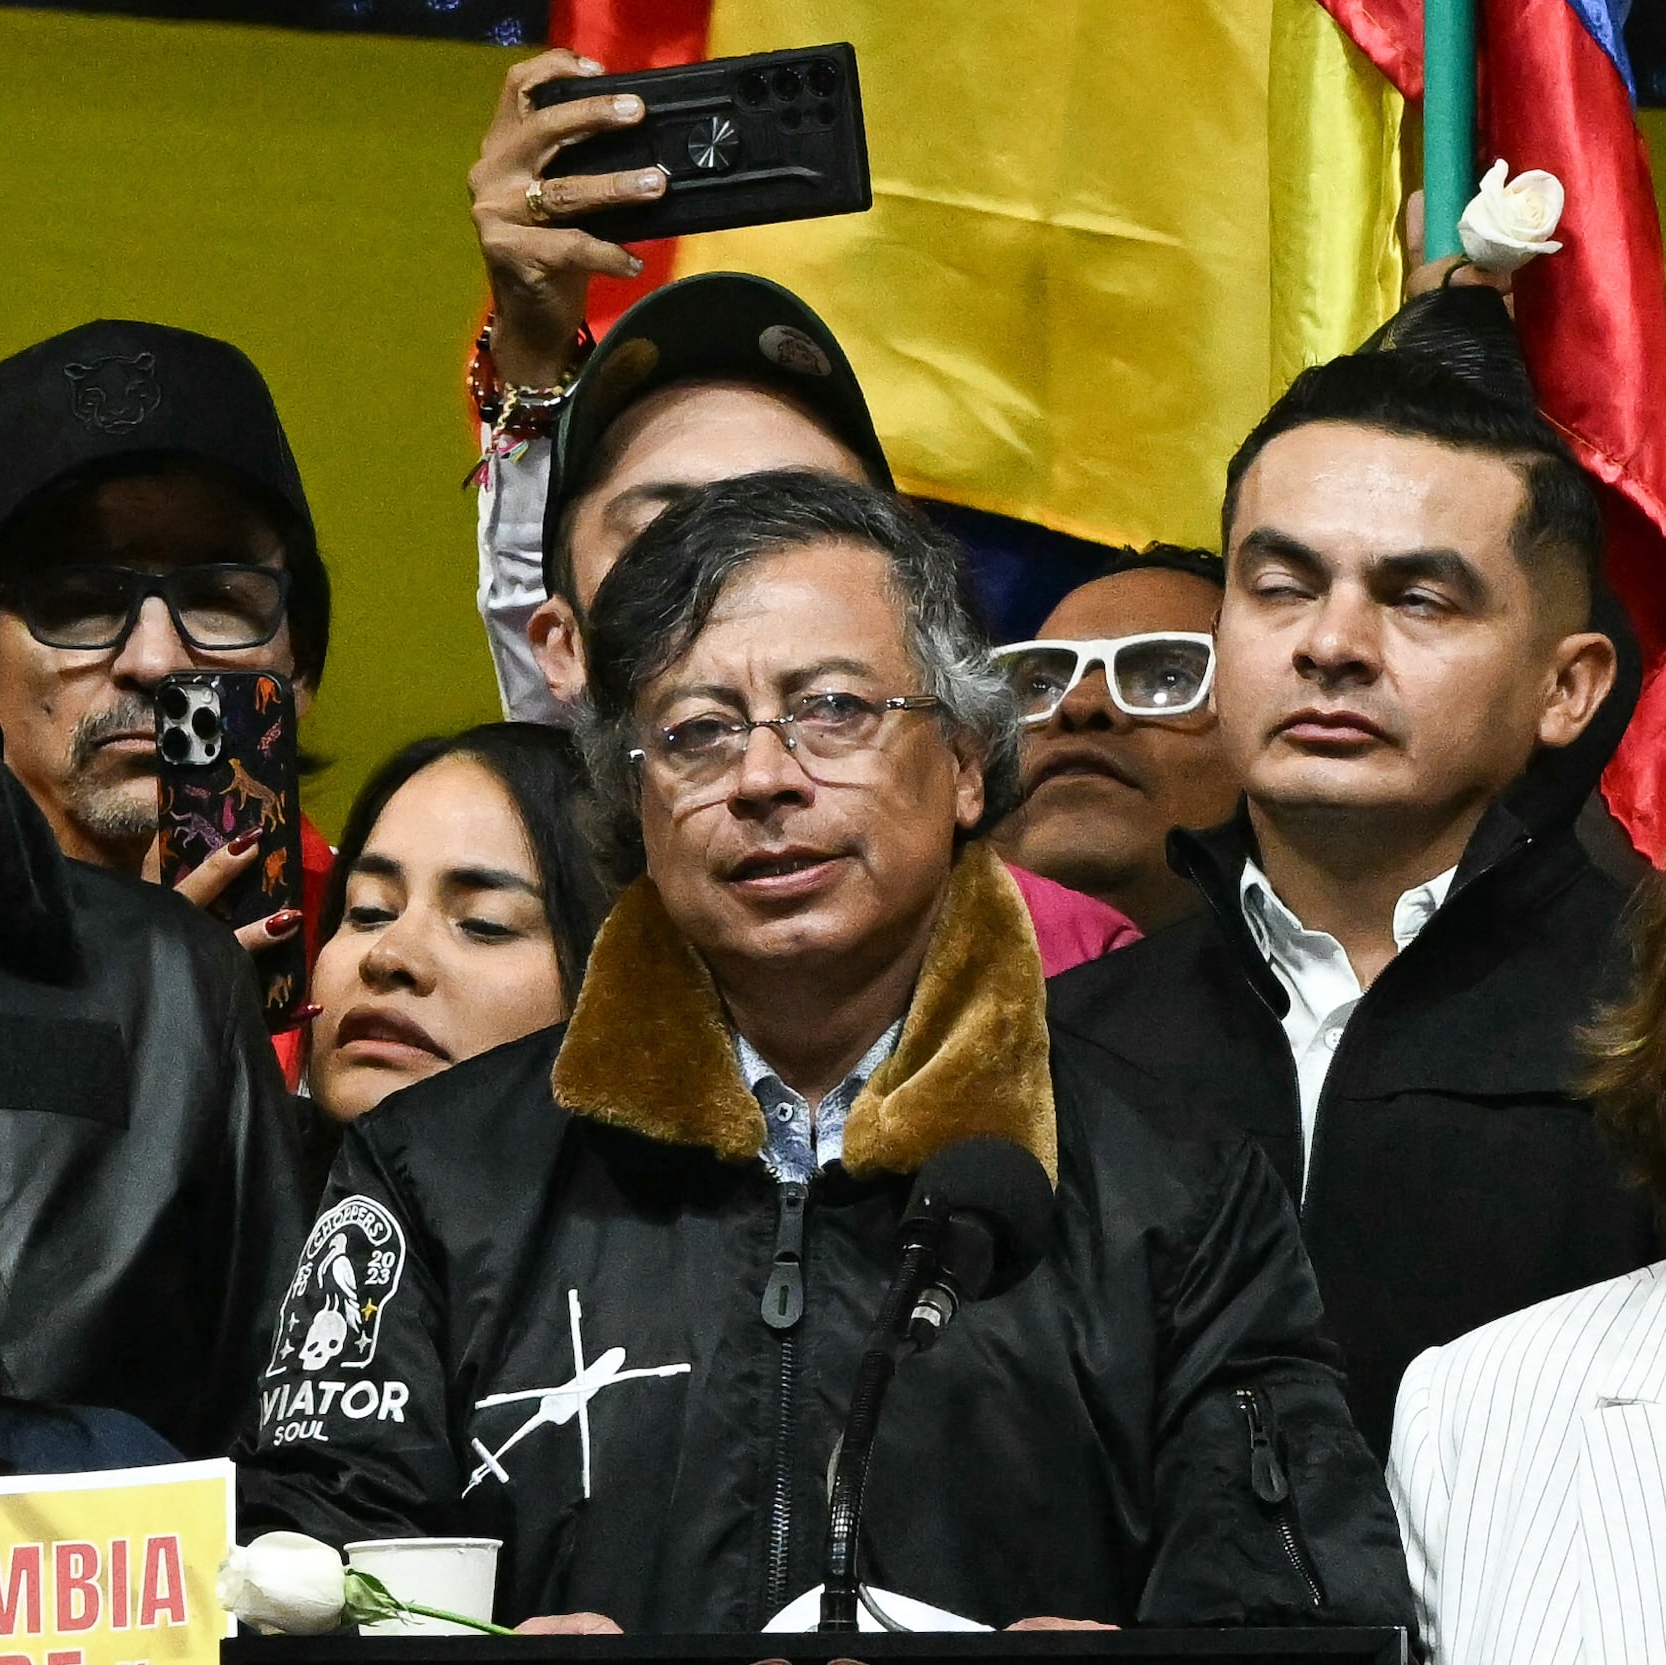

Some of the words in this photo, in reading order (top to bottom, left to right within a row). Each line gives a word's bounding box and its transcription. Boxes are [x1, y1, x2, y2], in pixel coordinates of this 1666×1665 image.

[313, 1204, 383, 1248] CHOPPERS
[367, 1250, 396, 1268] 20
[364, 1267, 391, 1286] 23
[273, 1419, 329, 1446] SOUL
